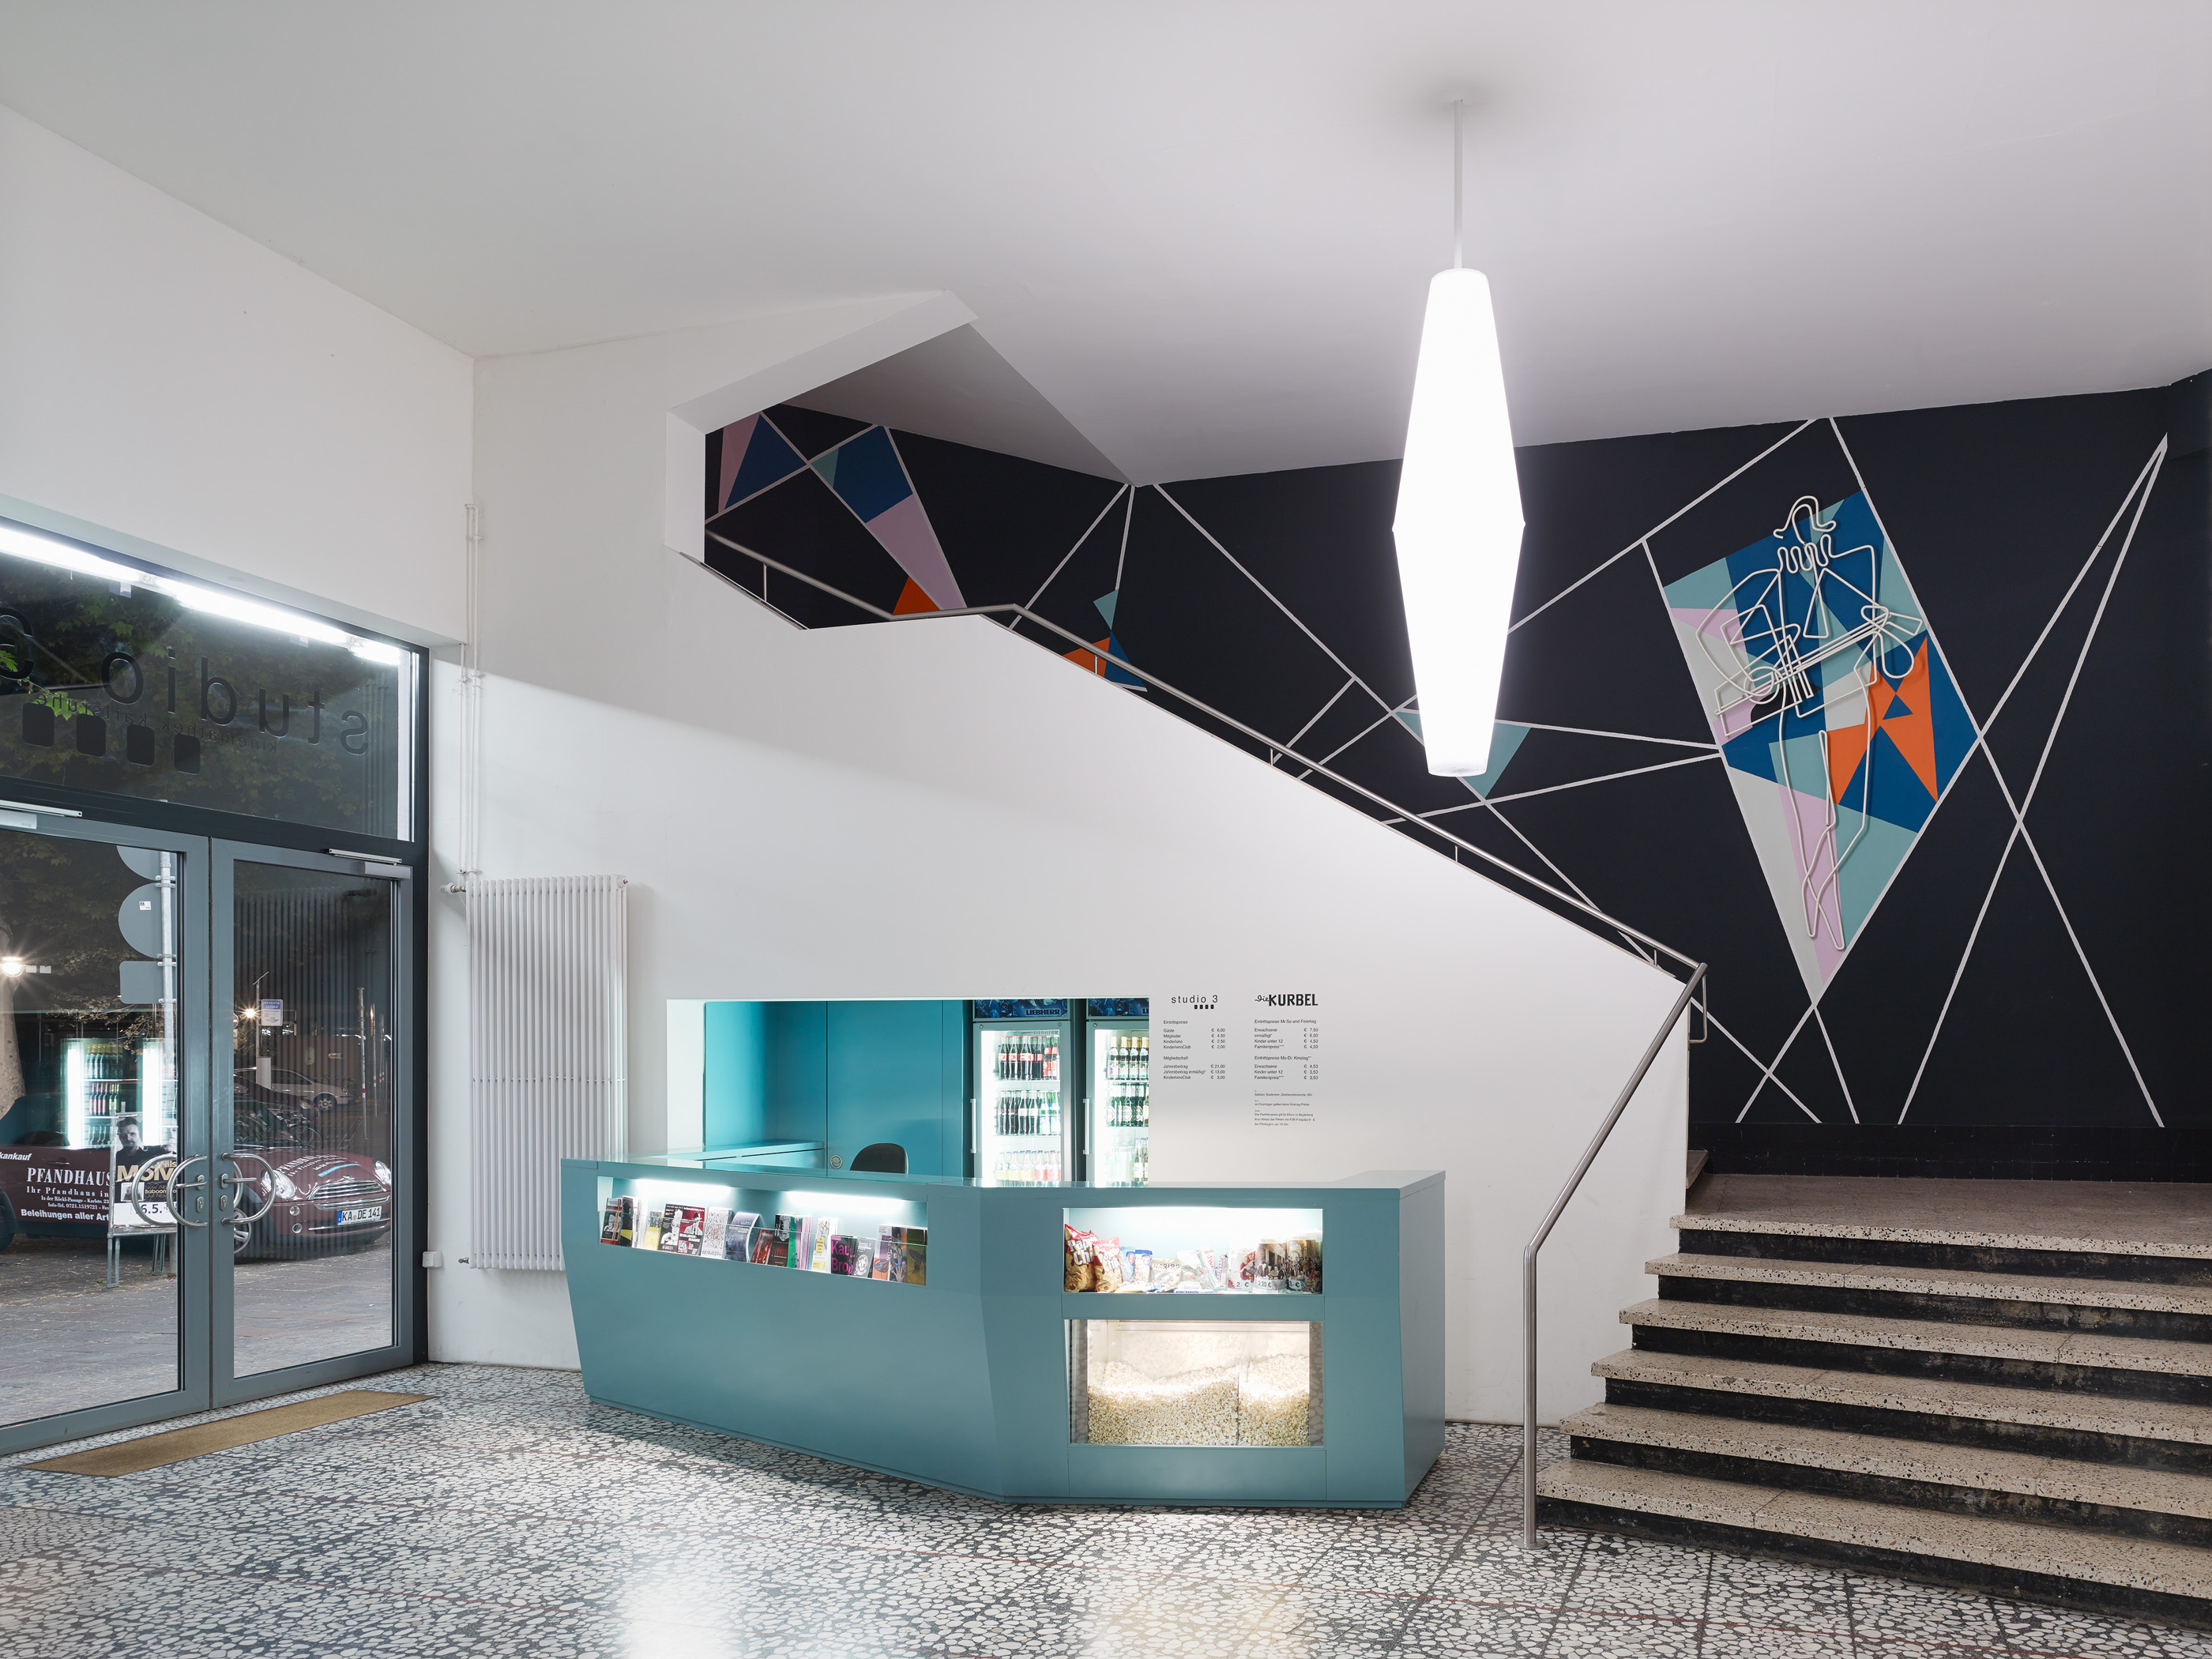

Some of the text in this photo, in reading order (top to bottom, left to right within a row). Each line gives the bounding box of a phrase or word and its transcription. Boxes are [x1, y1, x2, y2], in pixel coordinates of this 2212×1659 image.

[1171, 995, 1218, 1004] studio 3
[1268, 994, 1319, 1006] KURBEL
[27, 1186, 41, 1194] Ihr
[45, 1187, 96, 1197] Pfandhaus
[21, 1209, 109, 1221] Beleihungen aller Art
[342, 1207, 381, 1221] KA DE 141
